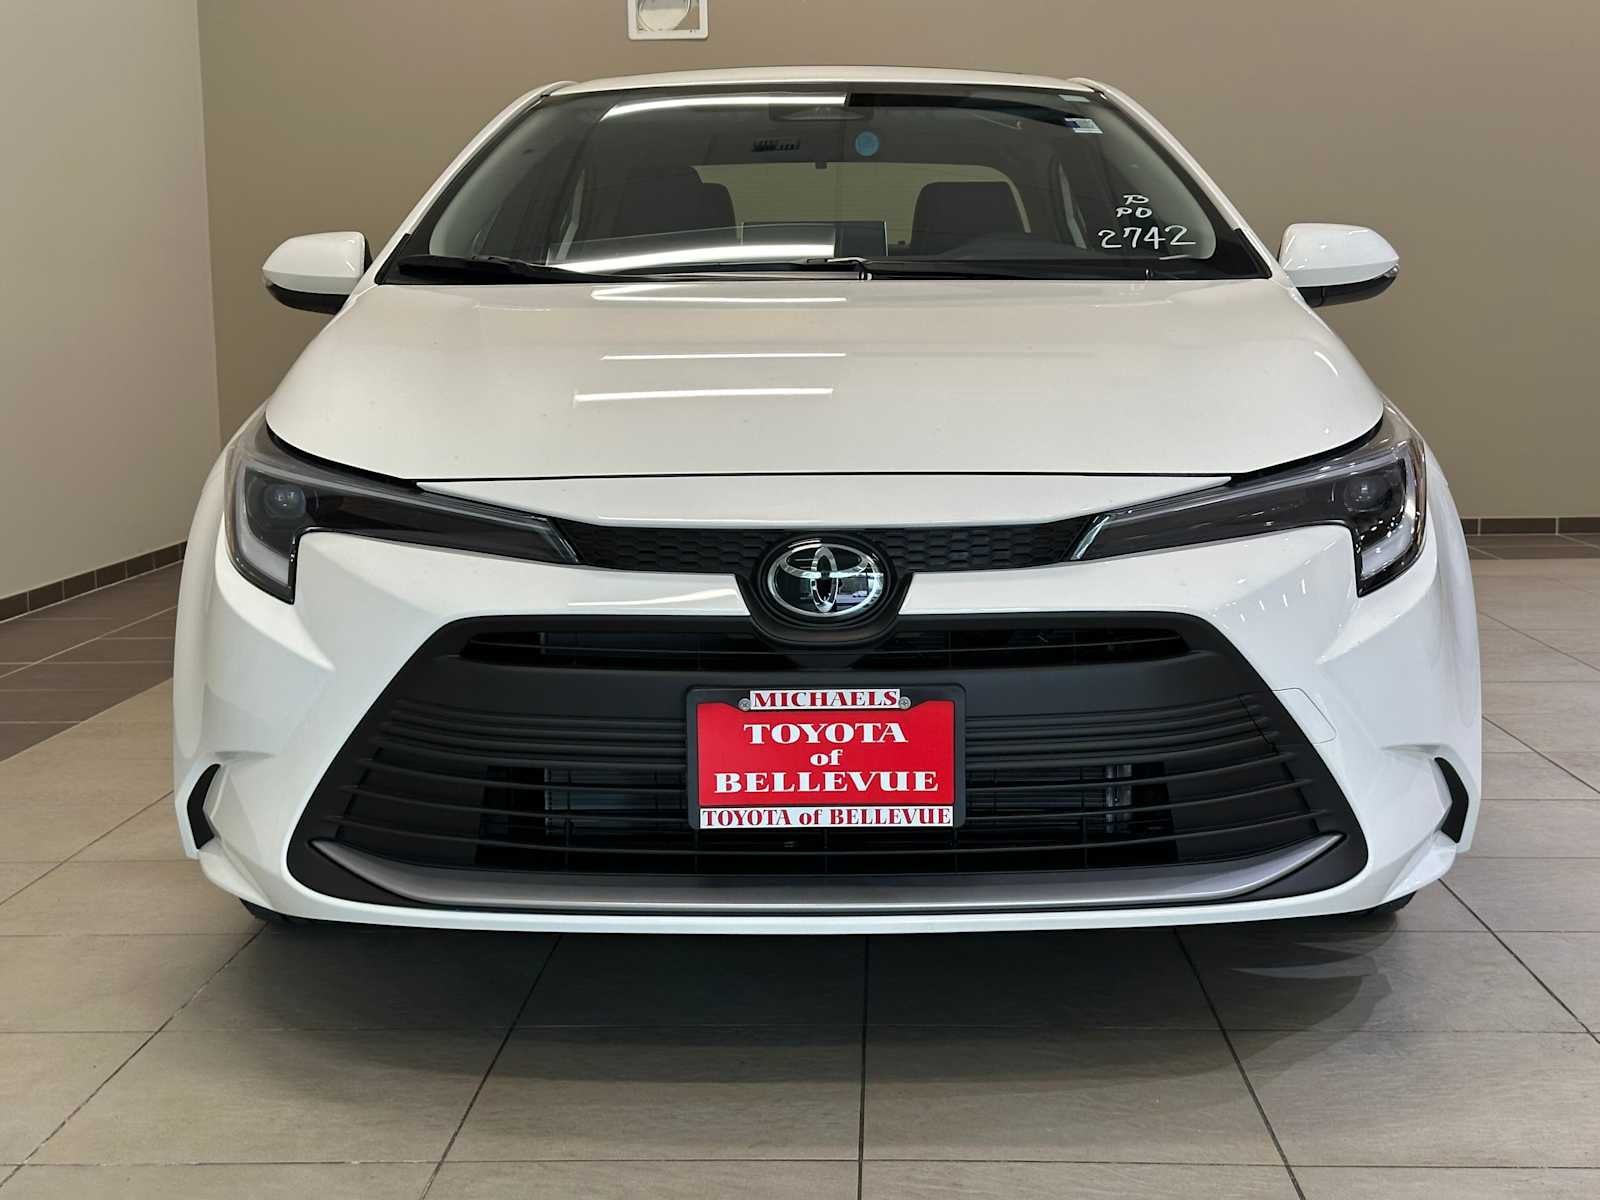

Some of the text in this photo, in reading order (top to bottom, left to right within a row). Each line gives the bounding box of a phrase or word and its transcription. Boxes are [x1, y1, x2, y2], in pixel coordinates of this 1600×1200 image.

[1098, 225, 1197, 250] 2742
[753, 690, 898, 707] MICHAELS
[743, 722, 908, 744] TOYOTA
[809, 749, 843, 766] of
[714, 771, 939, 794] BELLEVUE
[702, 808, 952, 826] TOYOTA of BELLEVUE
